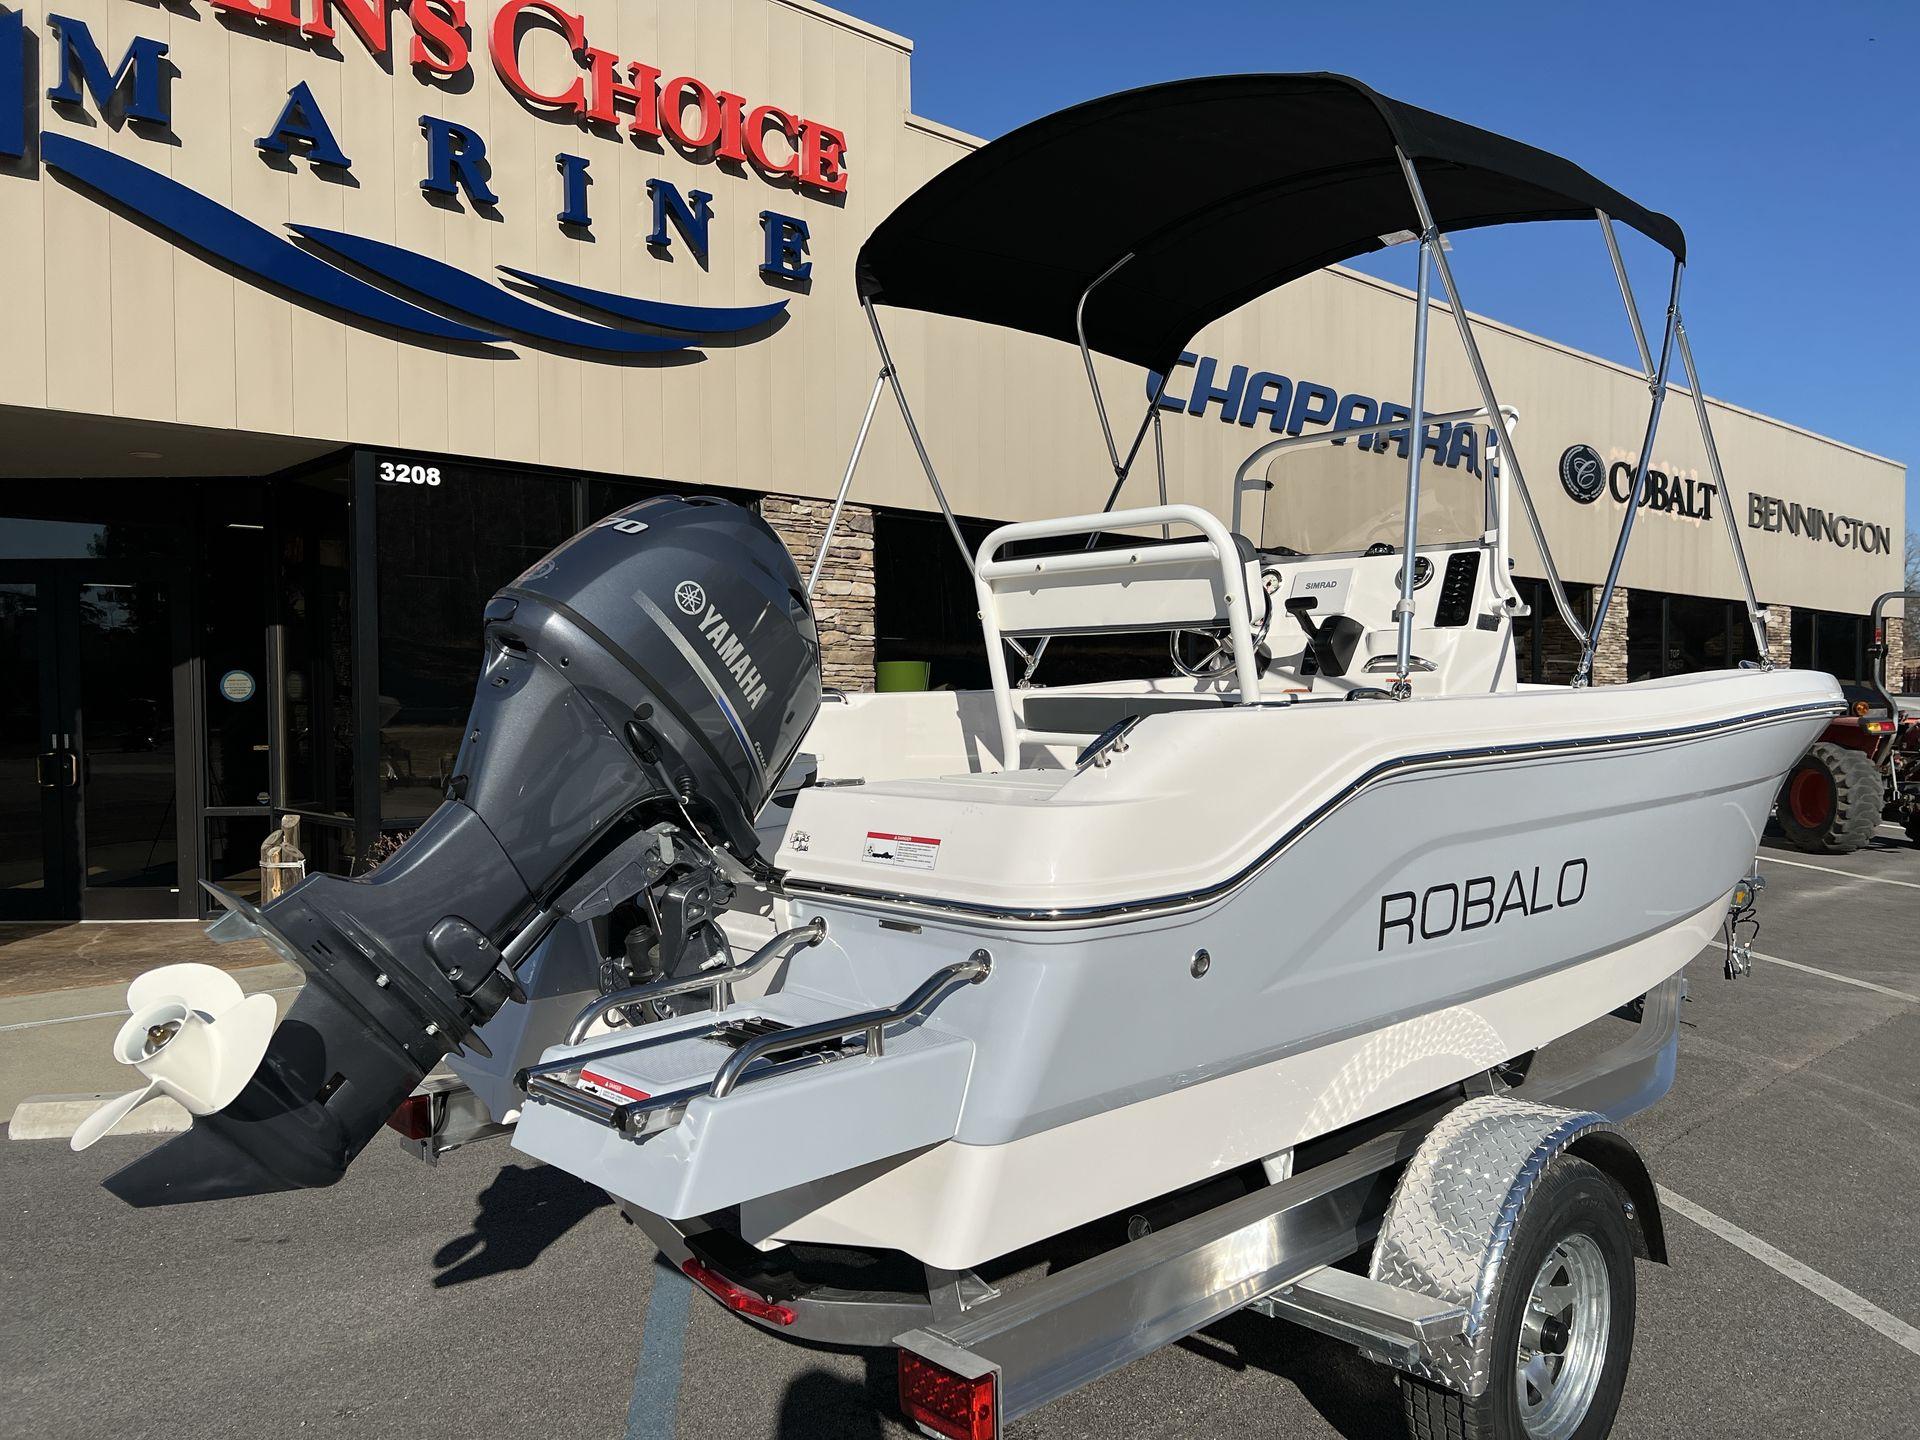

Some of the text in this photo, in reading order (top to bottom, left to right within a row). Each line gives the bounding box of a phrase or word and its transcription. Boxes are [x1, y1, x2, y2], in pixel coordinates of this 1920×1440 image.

[488, 0, 848, 193] CHOICE
[46, 12, 813, 281] MARINE
[380, 461, 441, 486] 3208
[1608, 461, 1718, 521] COBALT
[1747, 492, 1891, 555] BENNINGTON
[1304, 580, 1338, 590] SIMRAD
[698, 603, 768, 711] YAMAHA
[1377, 857, 1588, 952] ROBALO
